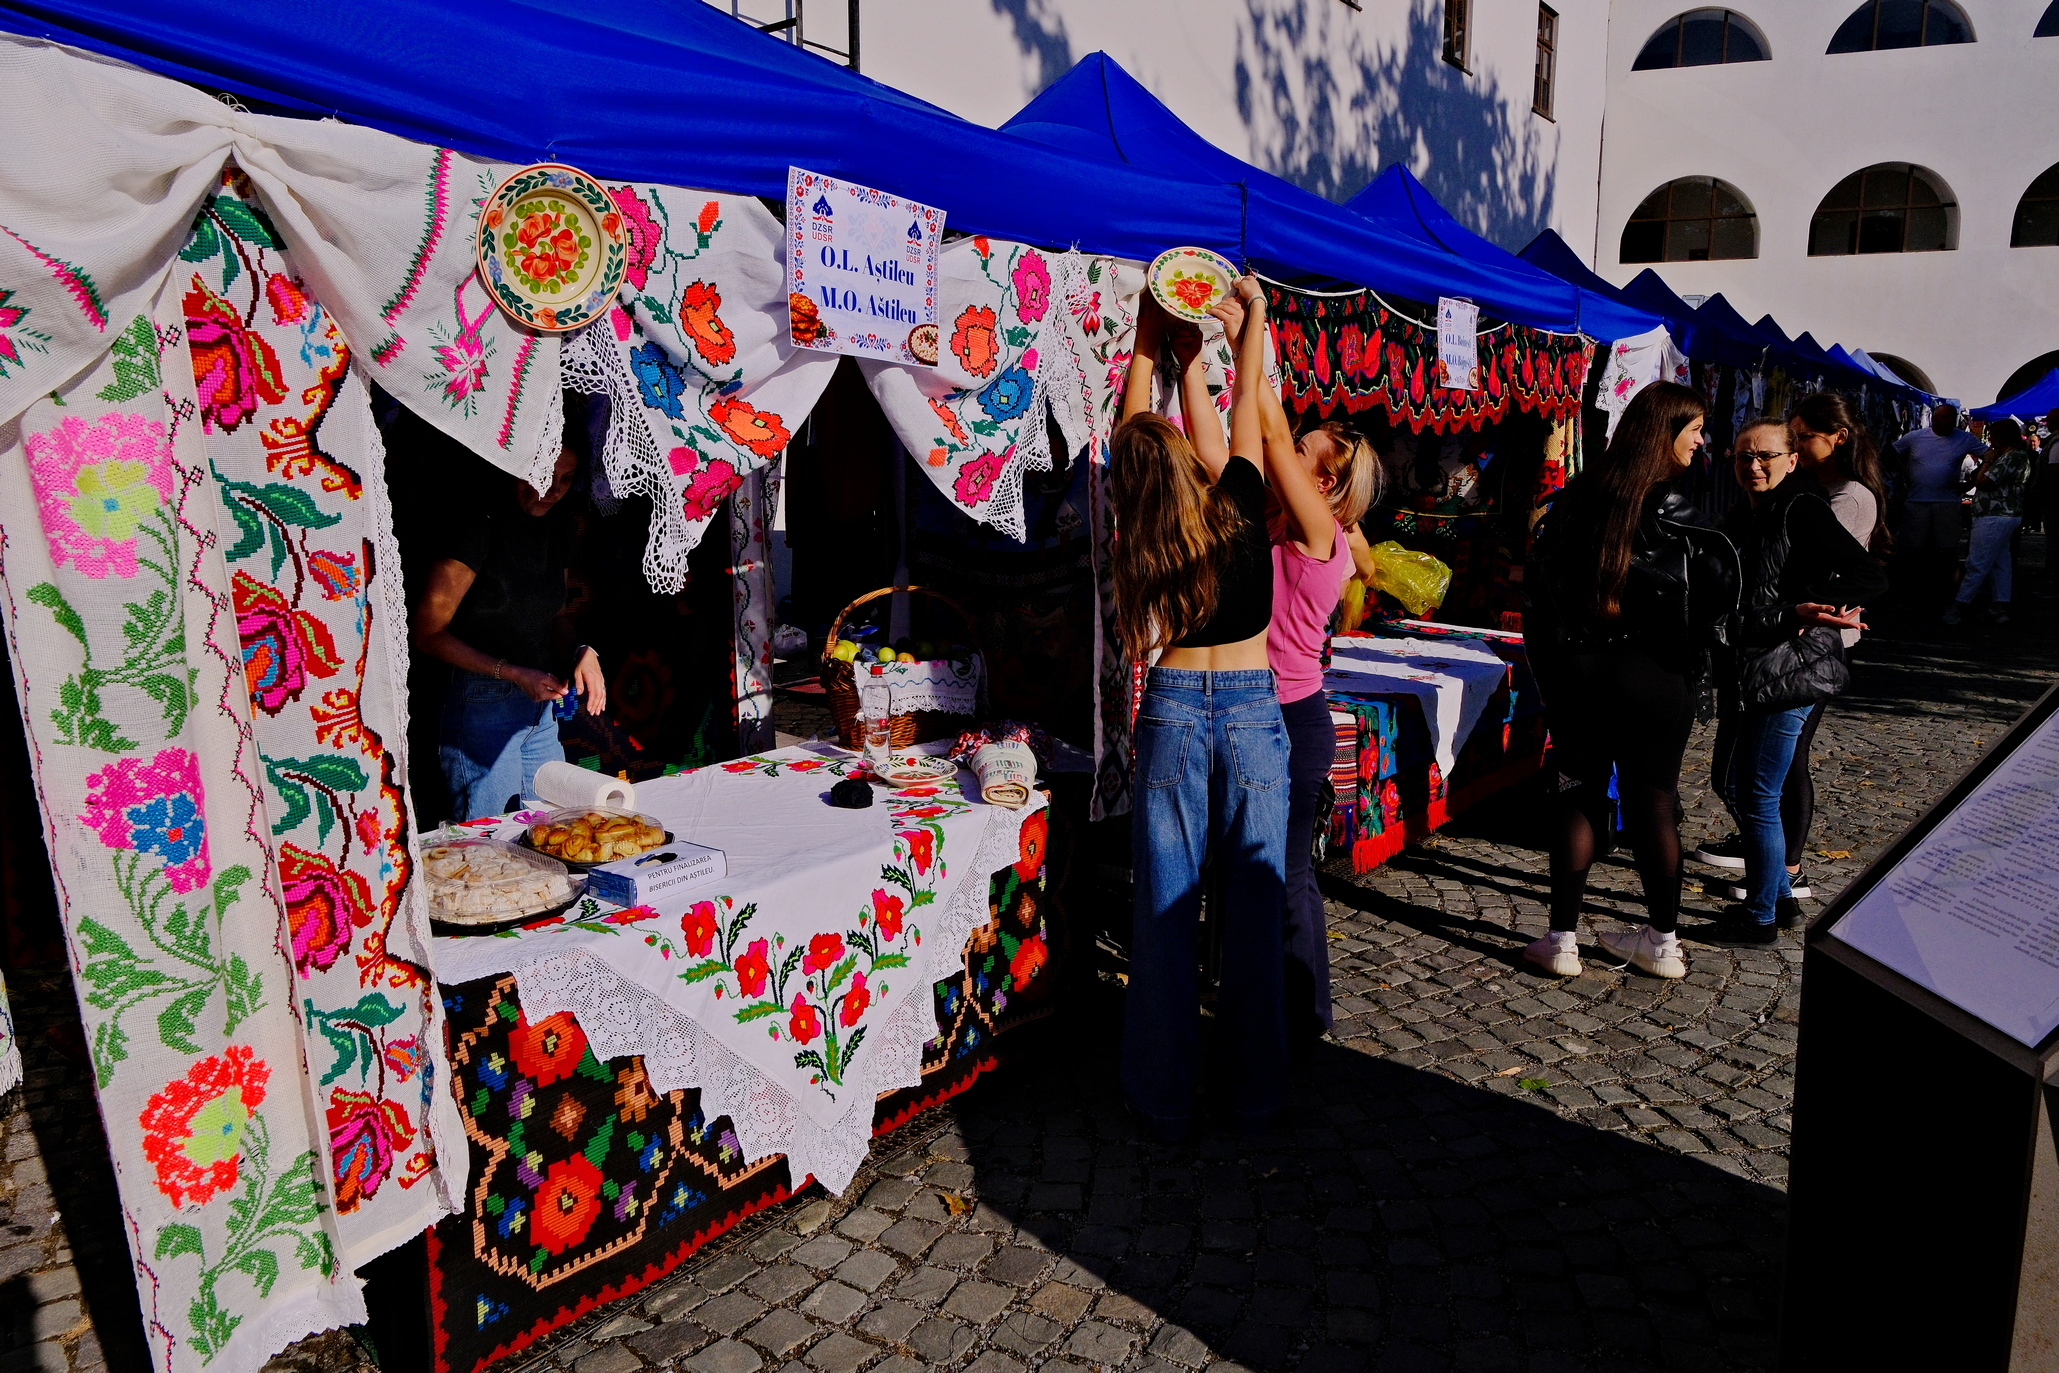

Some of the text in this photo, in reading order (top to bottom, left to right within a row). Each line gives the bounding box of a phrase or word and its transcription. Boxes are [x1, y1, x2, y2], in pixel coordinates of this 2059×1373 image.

[812, 222, 833, 233] DZSR
[812, 231, 833, 242] UDSR
[906, 245, 921, 256] DZSR
[821, 245, 915, 286] O.L. Aștileu
[906, 254, 921, 264] UDSR
[820, 285, 916, 324] M.O. Aštileu
[647, 867, 673, 880] PENTRU
[673, 855, 712, 872] FINALIZAREA
[648, 879, 676, 893] BISERICII
[676, 874, 689, 884] DIN
